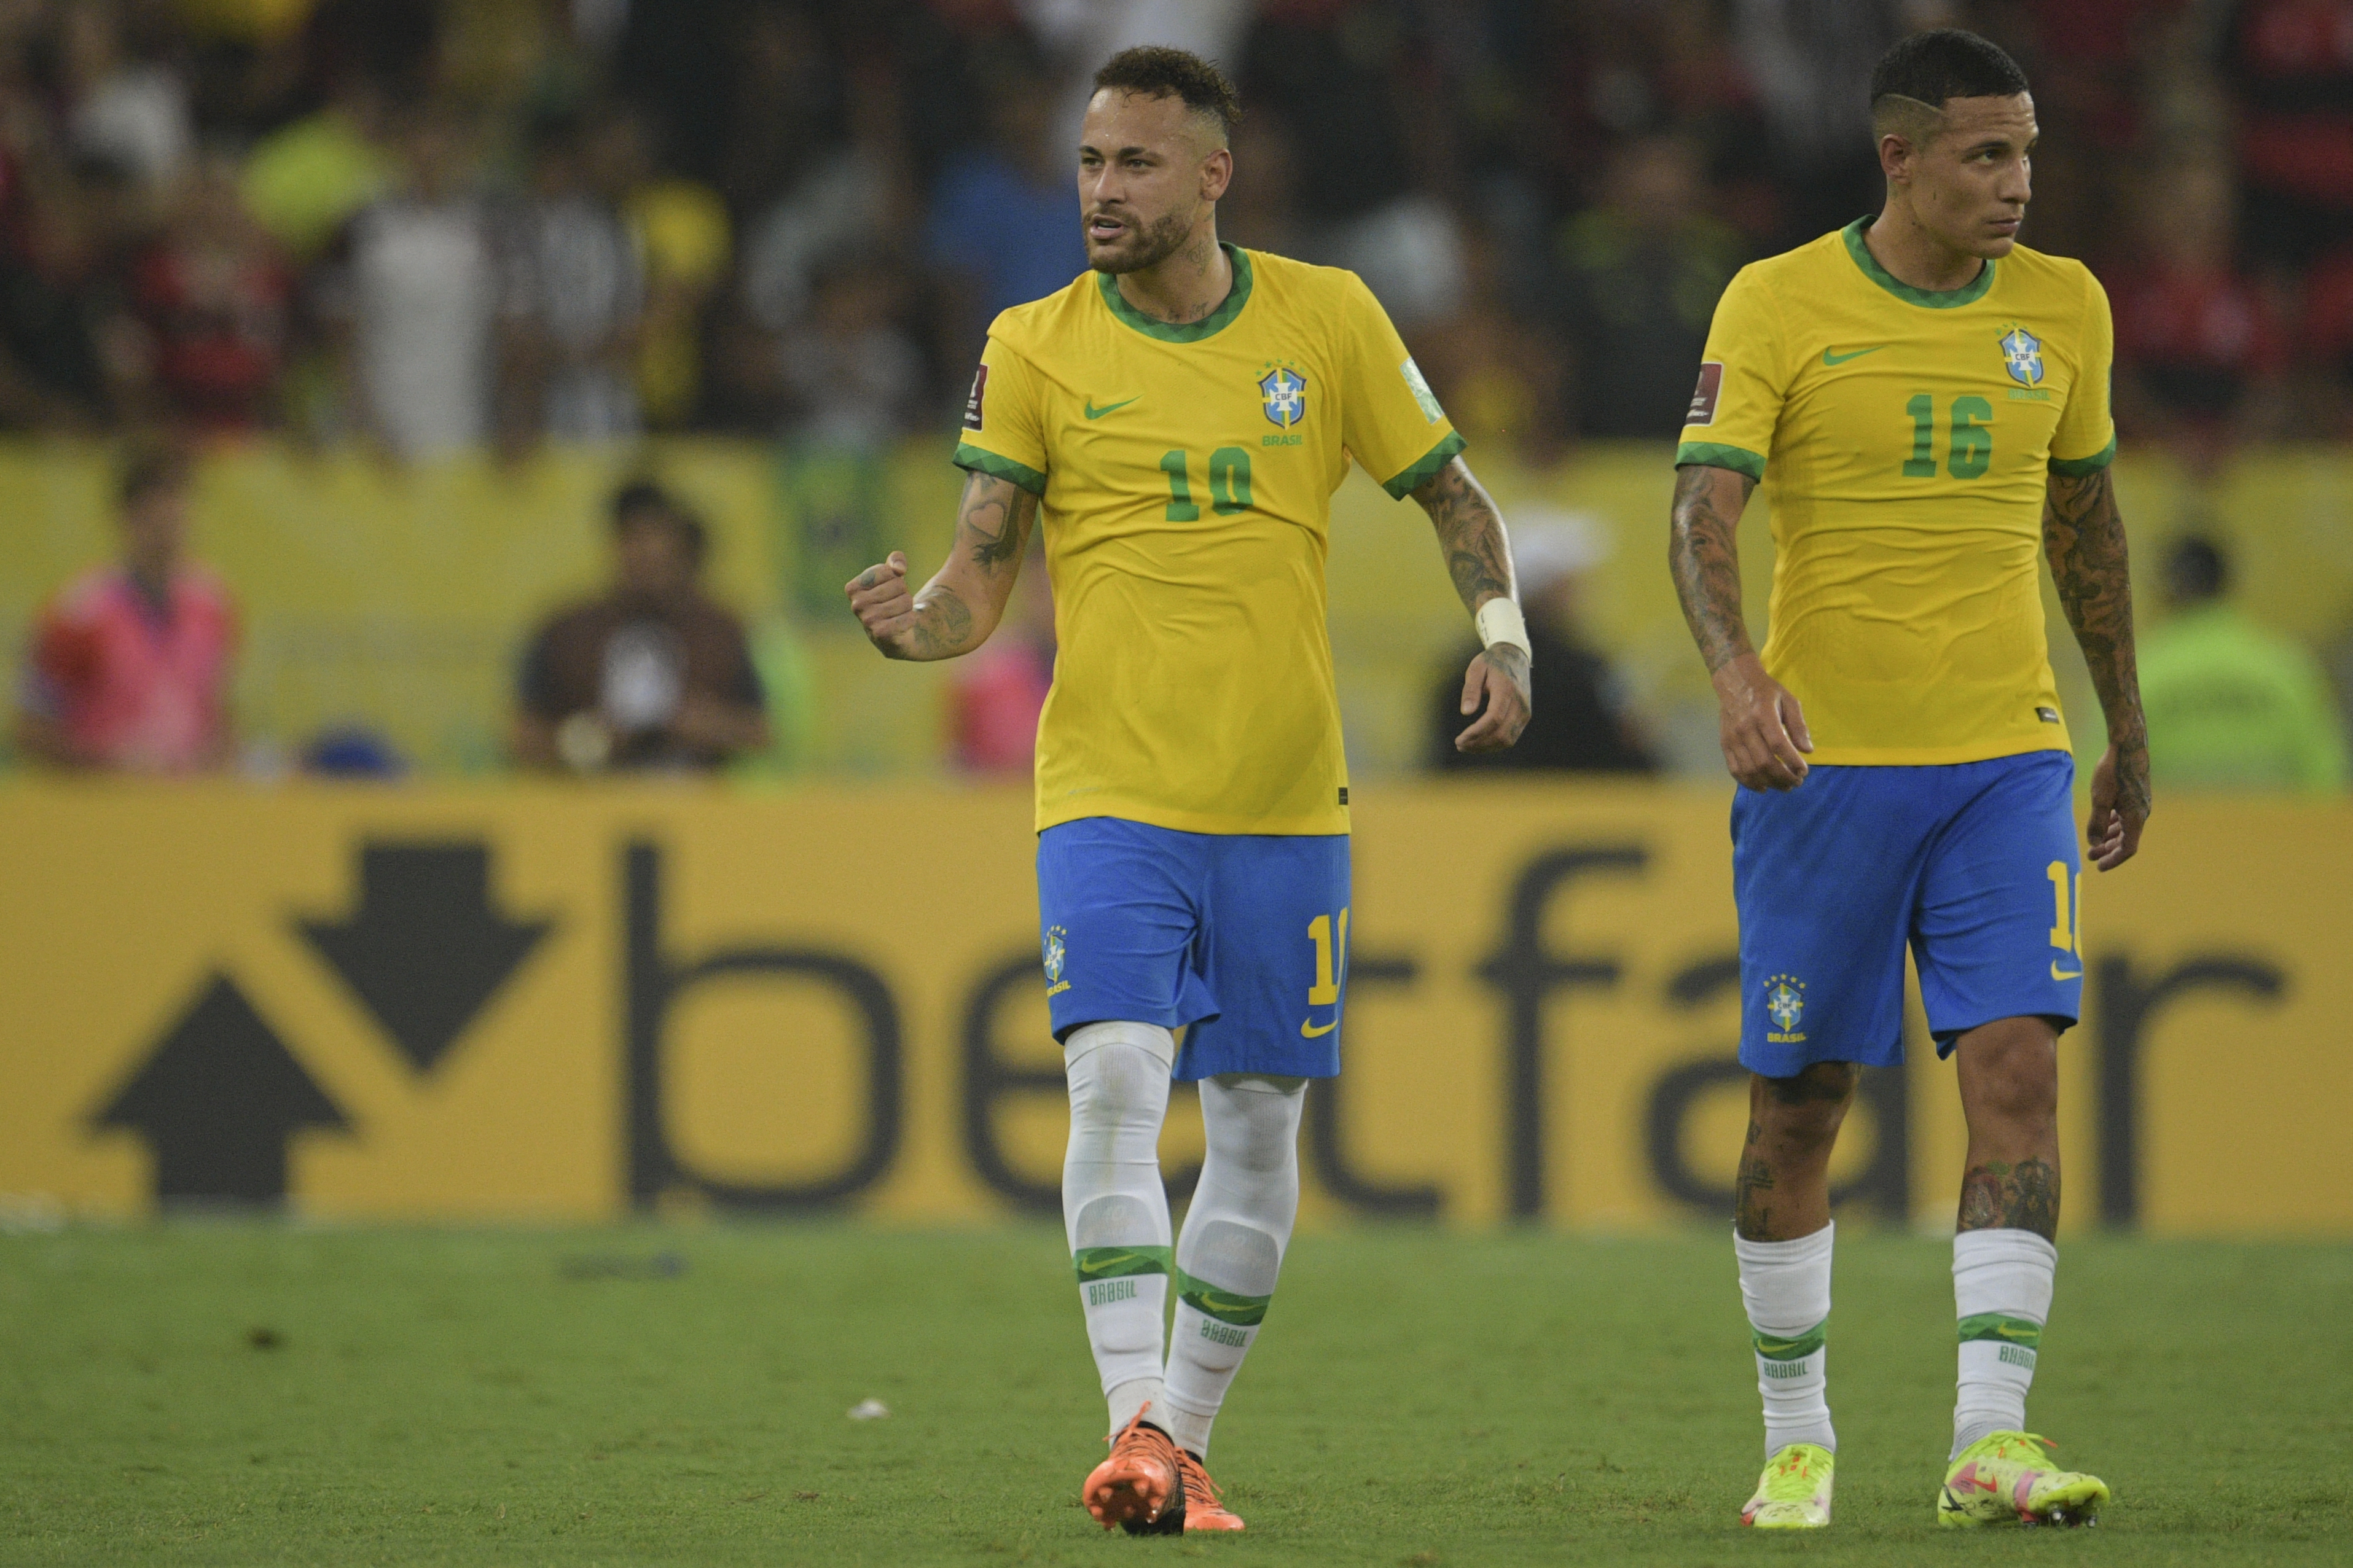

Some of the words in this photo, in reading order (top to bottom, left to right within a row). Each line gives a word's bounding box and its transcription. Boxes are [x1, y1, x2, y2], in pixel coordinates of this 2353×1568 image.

[2008, 388, 2051, 401] BRASIL
[1261, 434, 1303, 447] BRASIL
[1902, 394, 1994, 480] 16
[1159, 446, 1254, 523] 10
[1767, 1032, 1807, 1043] BRASIL
[1089, 1279, 1138, 1306] BRASIL
[1199, 1319, 1250, 1348] BRASIL
[1763, 1360, 1809, 1379] BRASIL
